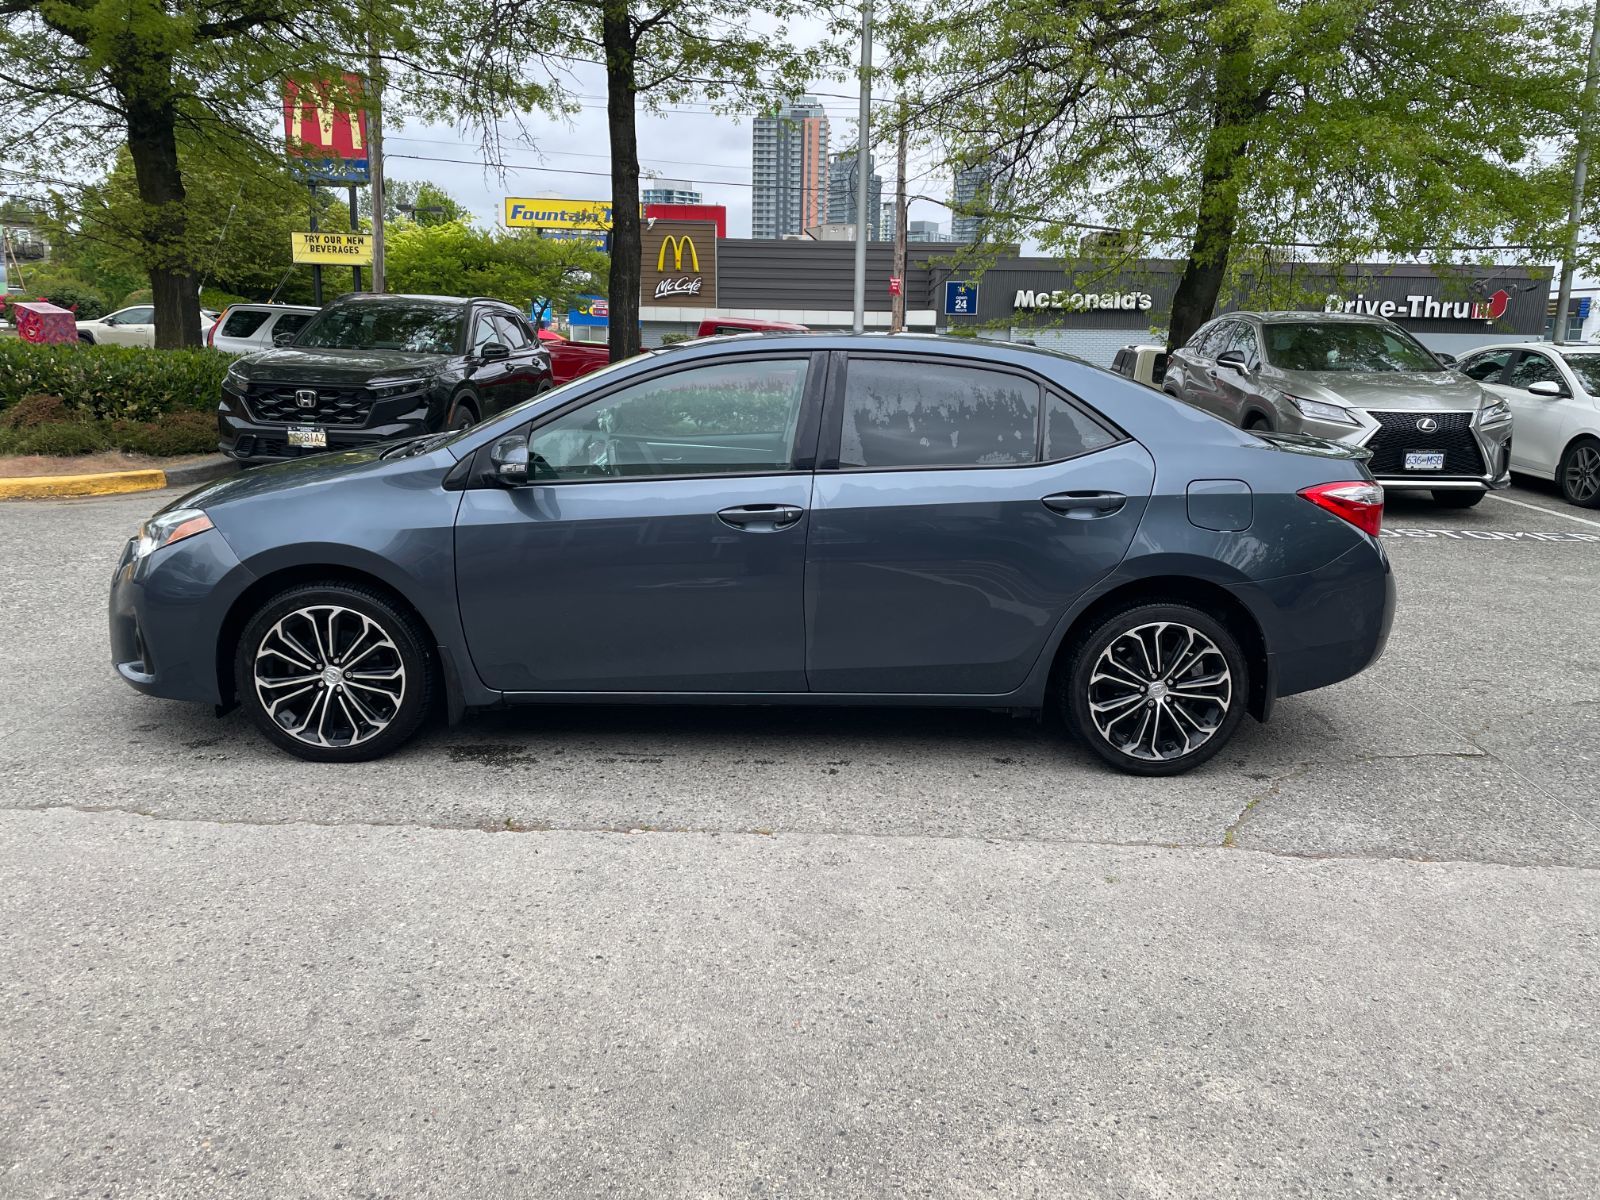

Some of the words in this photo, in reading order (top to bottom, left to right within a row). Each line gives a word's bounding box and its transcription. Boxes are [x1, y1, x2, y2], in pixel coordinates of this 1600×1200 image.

[511, 204, 599, 222] Fountain
[304, 235, 320, 243] TRY
[324, 236, 342, 244] OUR
[346, 236, 364, 245] NEW
[310, 244, 359, 254] BEVERAGES
[955, 300, 967, 309] 24
[1014, 290, 1152, 310] McDonald's
[1325, 294, 1469, 319] Drive-Thru
[1379, 528, 1600, 542] USTOMER
